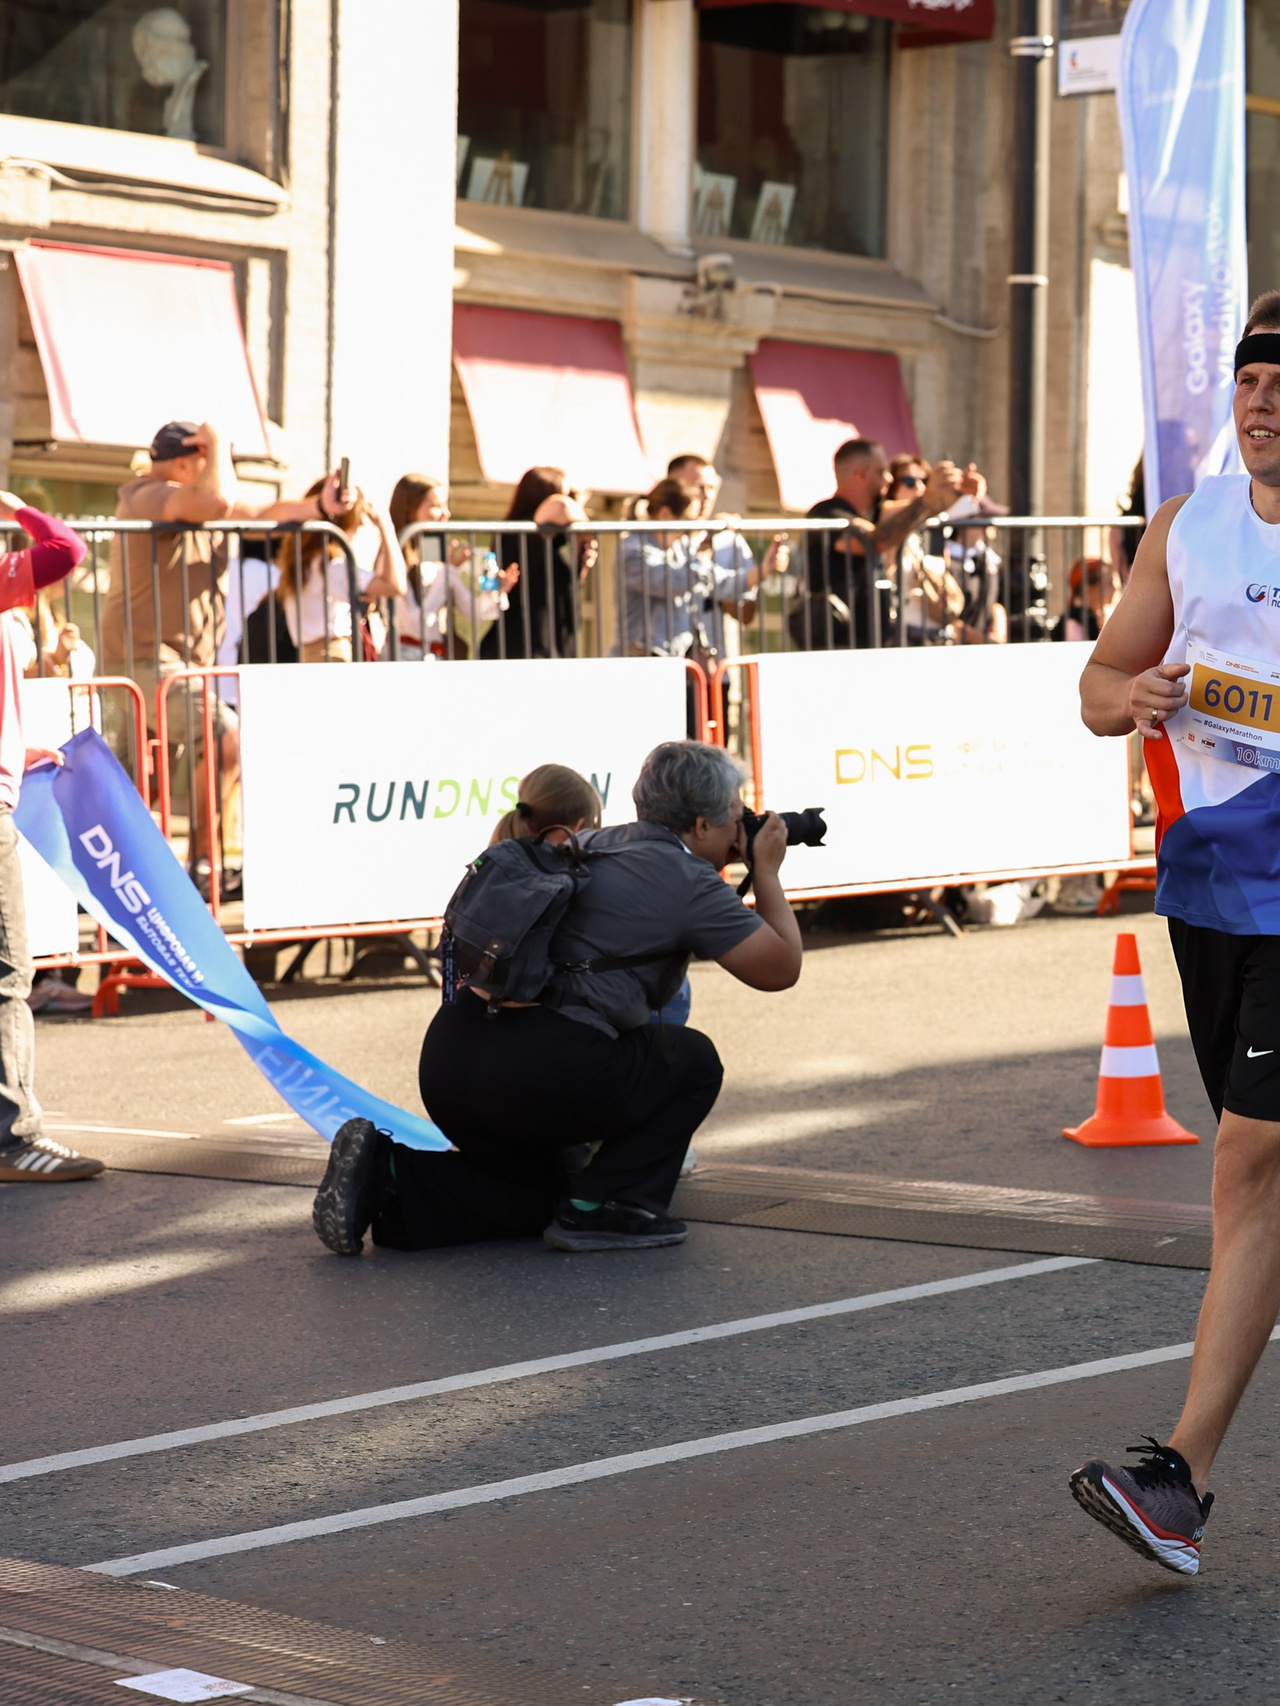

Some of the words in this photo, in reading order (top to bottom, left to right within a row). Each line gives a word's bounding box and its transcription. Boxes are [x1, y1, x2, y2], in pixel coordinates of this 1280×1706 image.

[1182, 276, 1209, 395] Galaxy
[1204, 679, 1273, 721] 6011
[1204, 719, 1263, 741] #GalaxyMarathon
[835, 744, 934, 784] DNS
[1237, 747, 1280, 770] 10km
[332, 772, 612, 824] RUNDNSN
[79, 824, 151, 915] DNS
[136, 915, 177, 967] БЫТОВАЯ
[147, 907, 196, 971] ЦИФРОВАЯ
